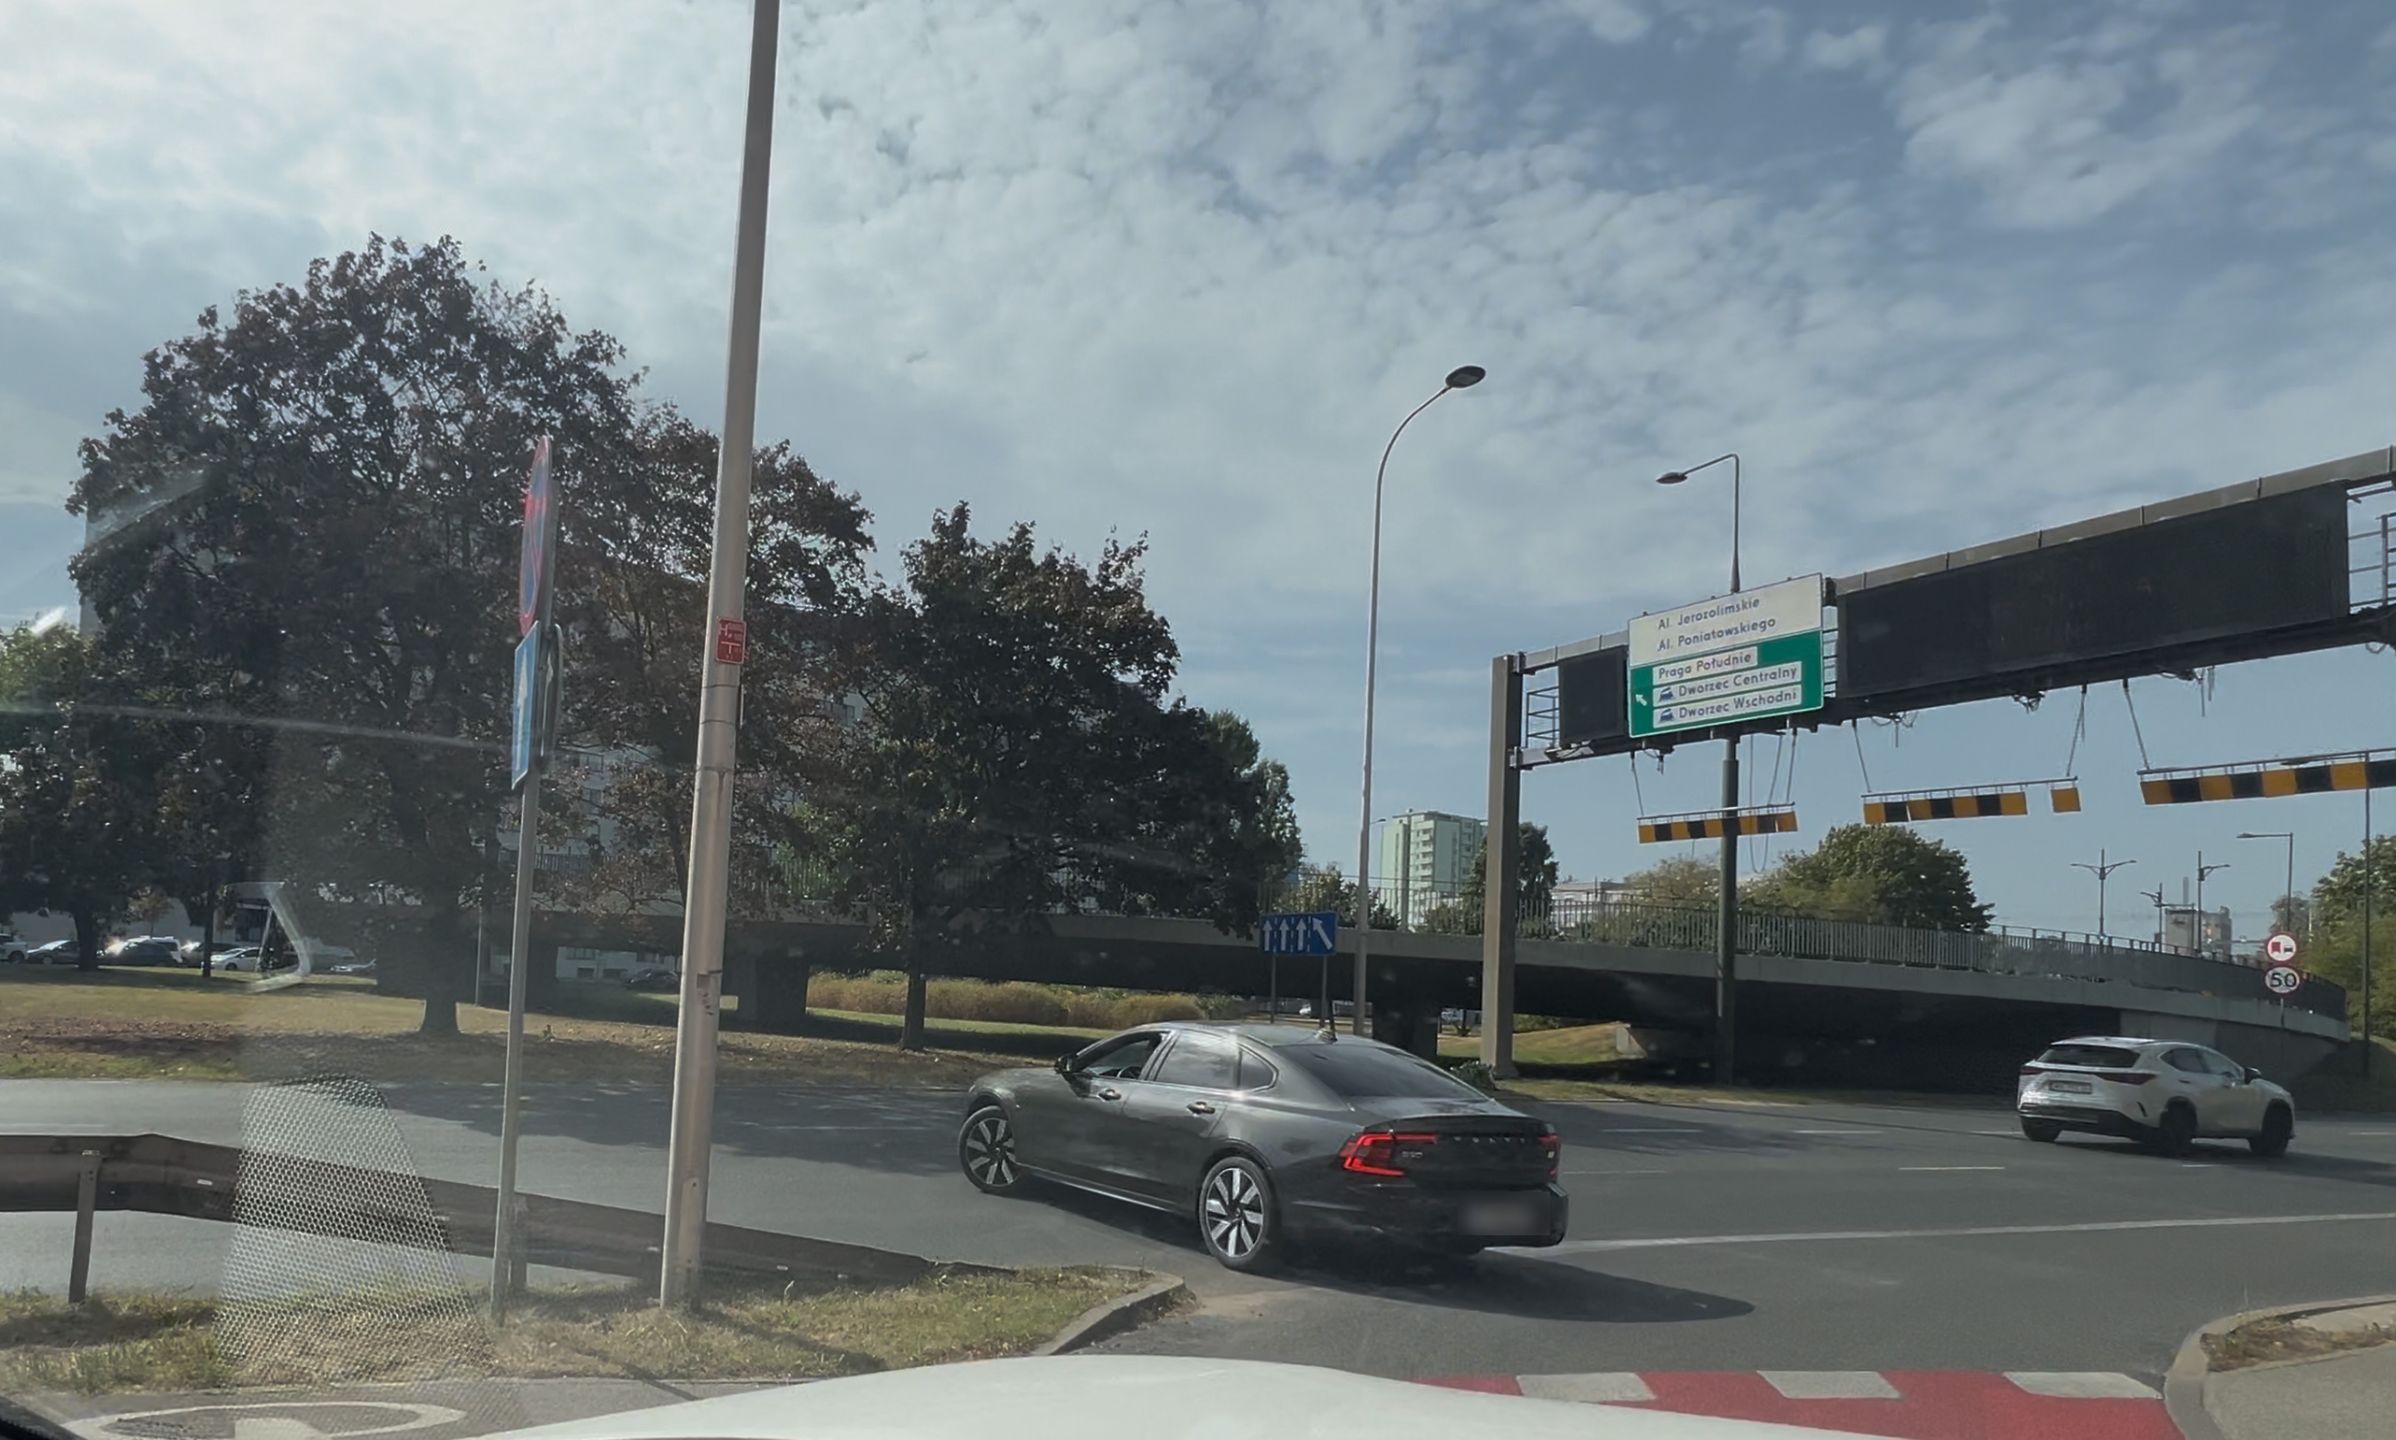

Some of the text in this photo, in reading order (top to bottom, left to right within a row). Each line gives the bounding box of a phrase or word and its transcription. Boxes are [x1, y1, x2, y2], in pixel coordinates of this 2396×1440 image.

[1677, 597, 1760, 626] Jerozolimskie
[1657, 616, 1776, 652] Al. Poniatowskiego
[1658, 653, 1752, 680] Praga Południe
[1678, 667, 1797, 697] Dworzec Centralny
[1678, 690, 1797, 719] Dworzec Wschodni
[2270, 972, 2297, 988] 50
